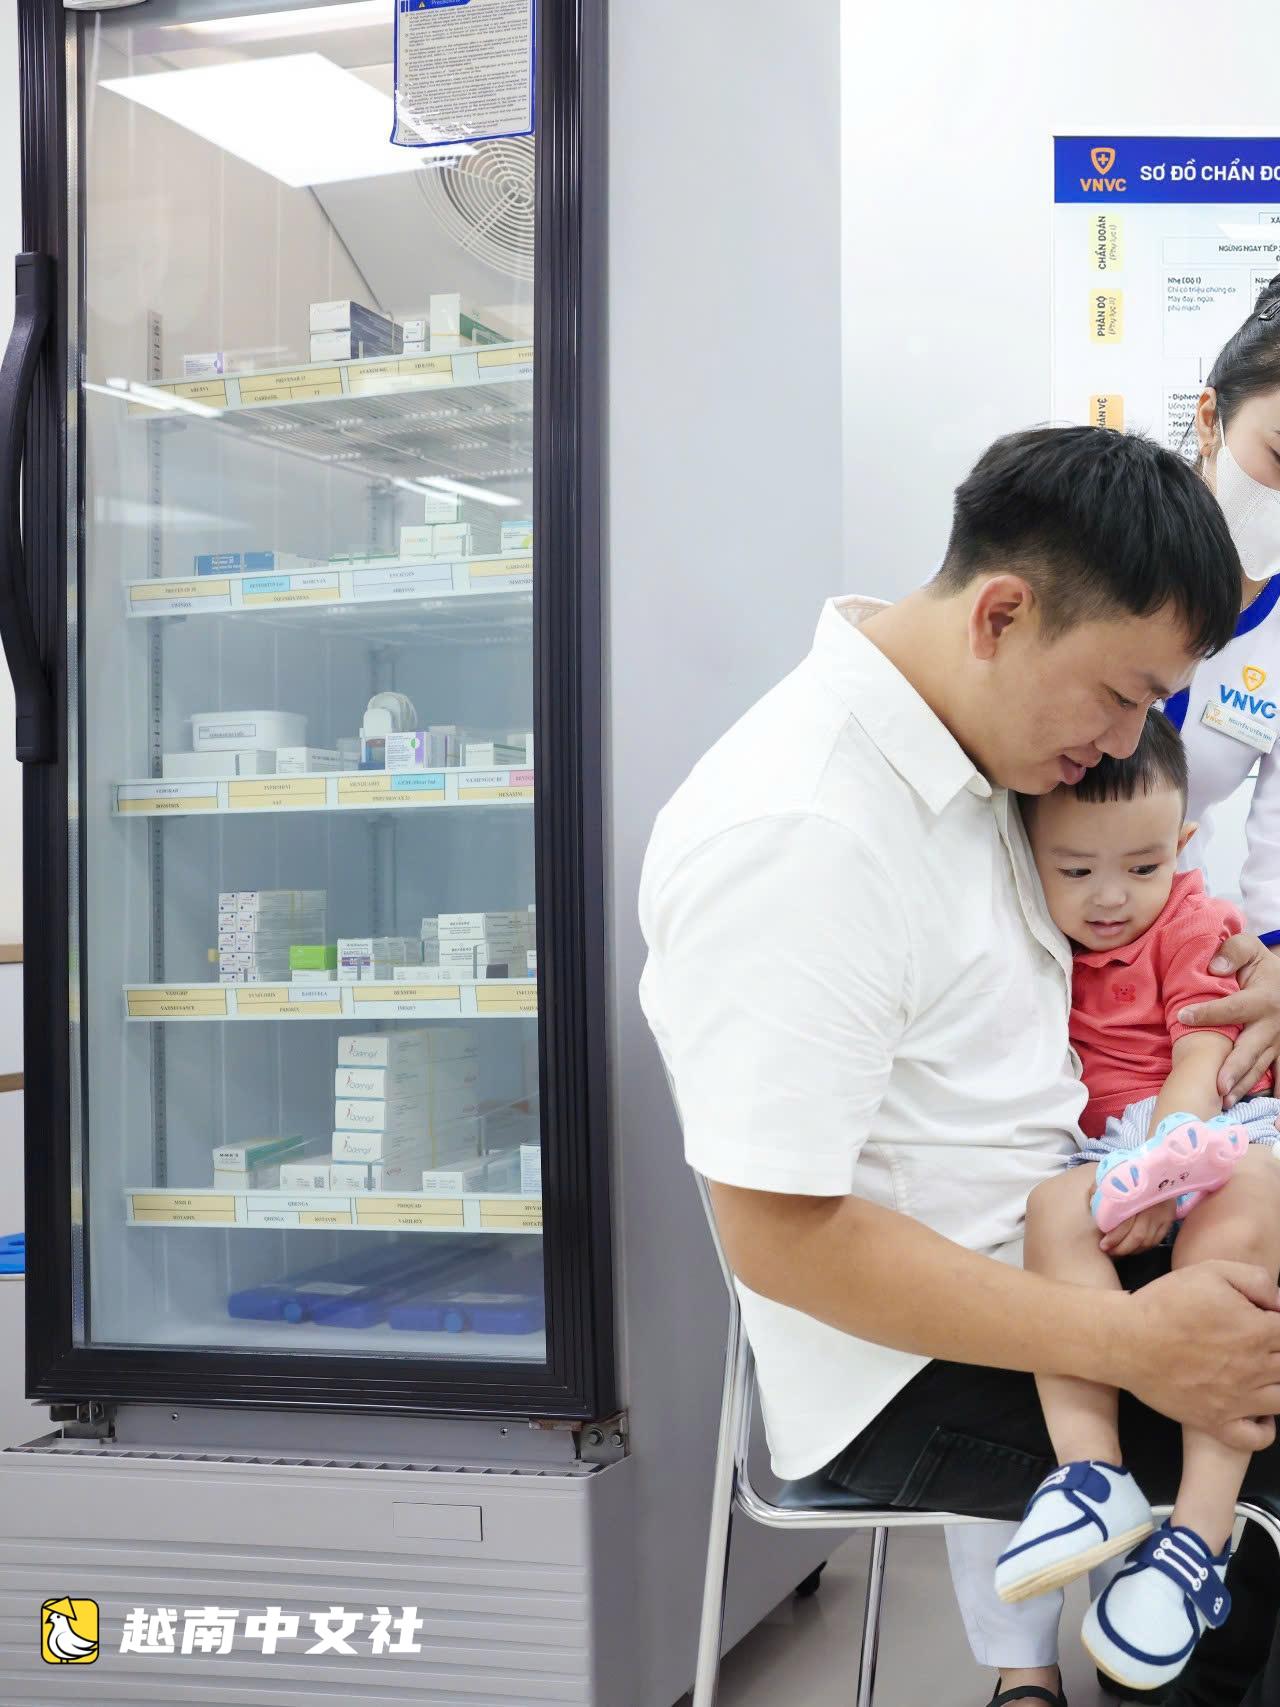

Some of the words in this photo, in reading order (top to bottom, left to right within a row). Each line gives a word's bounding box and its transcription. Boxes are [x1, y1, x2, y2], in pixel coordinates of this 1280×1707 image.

[1140, 162, 1166, 181] SƠ
[1170, 158, 1197, 181] ĐỒ
[1201, 157, 1255, 181] CHẨN
[1080, 178, 1127, 192] VNVC
[1220, 684, 1278, 719] VNVC
